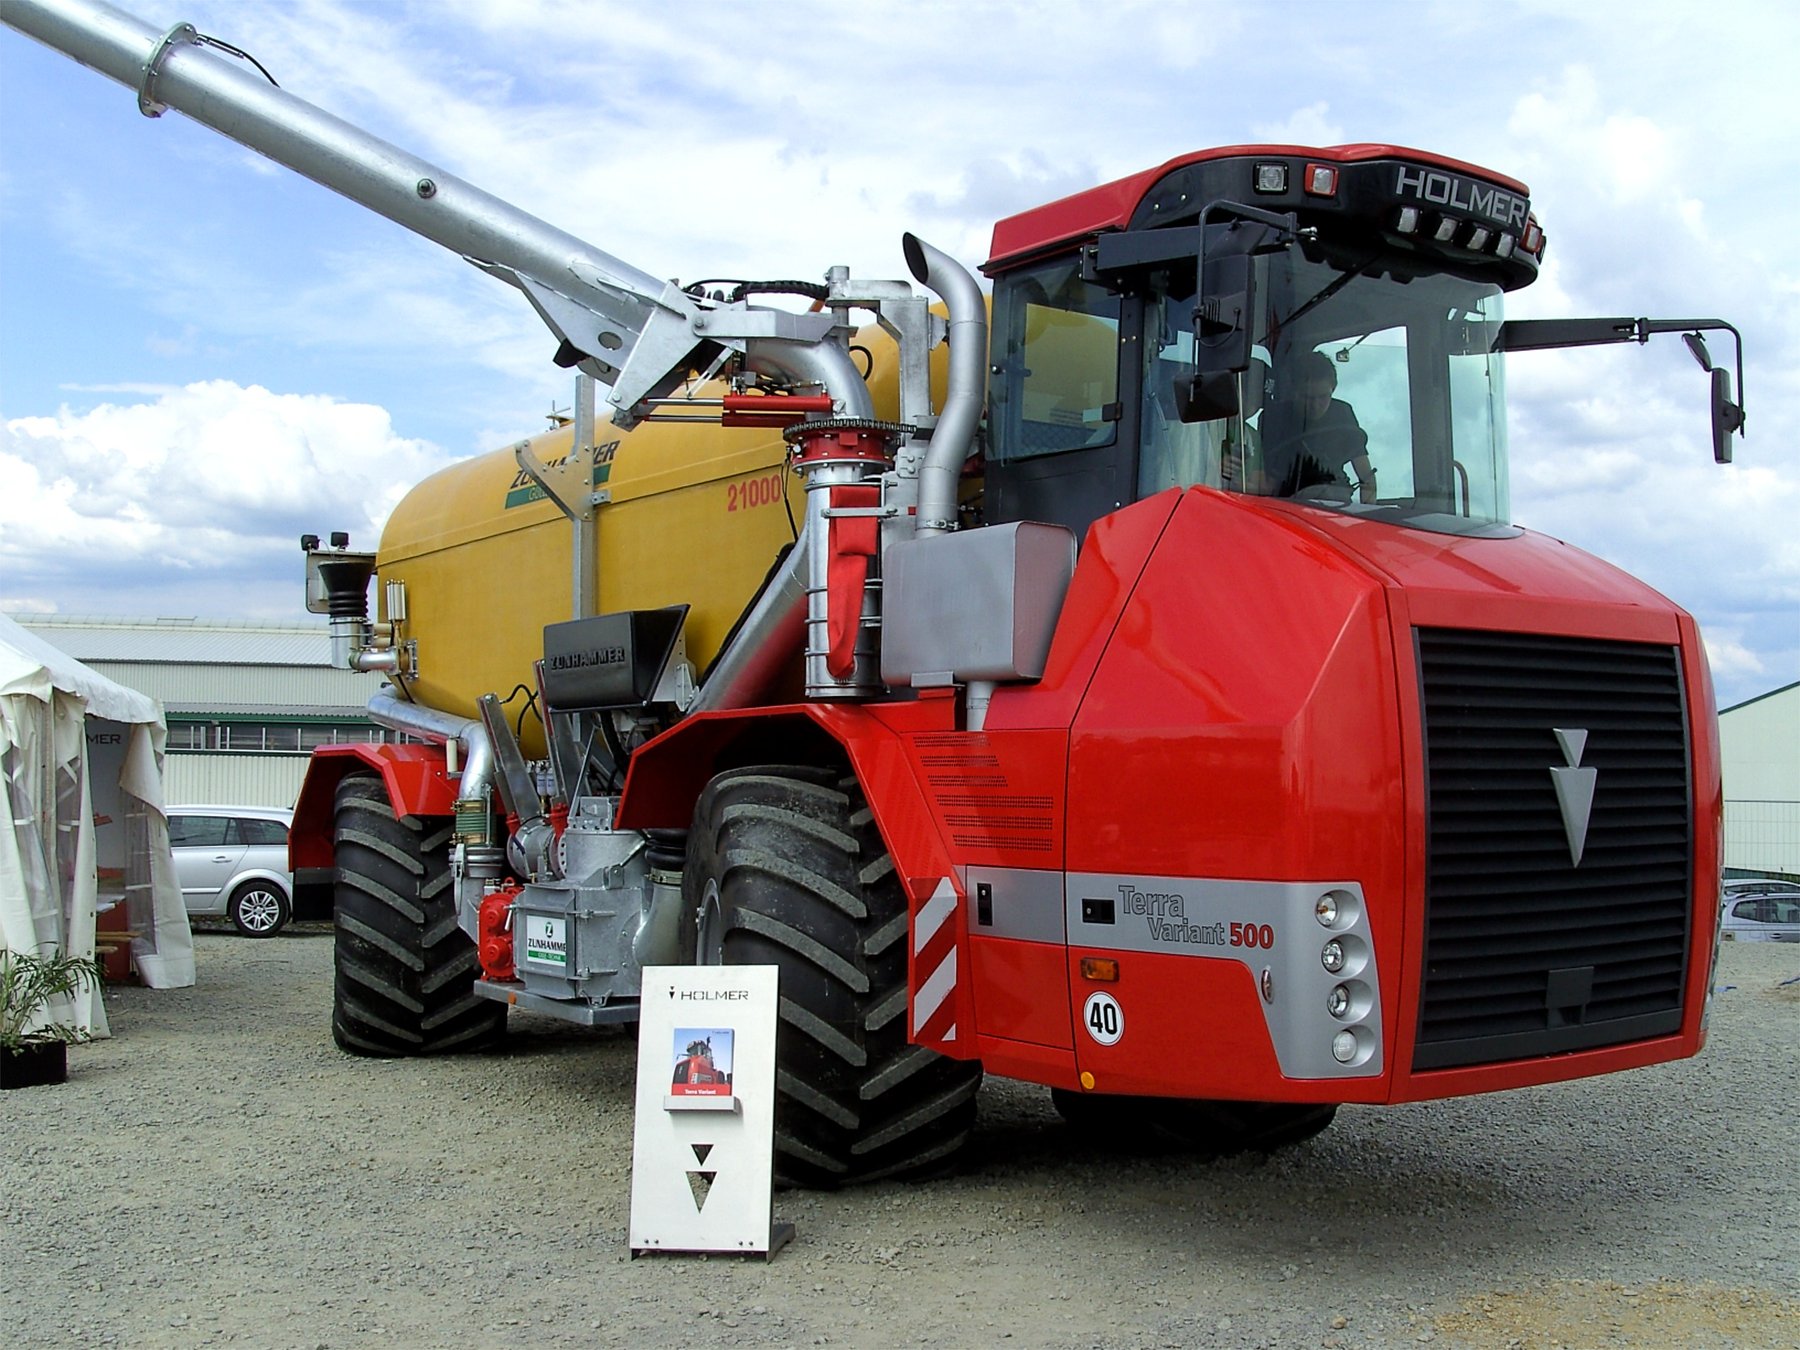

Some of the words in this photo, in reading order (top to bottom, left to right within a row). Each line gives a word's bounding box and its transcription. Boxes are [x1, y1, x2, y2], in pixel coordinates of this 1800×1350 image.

[1396, 166, 1526, 228] HOLMER
[727, 473, 781, 512] 21000
[551, 647, 625, 670] ZUNHAMMER
[1118, 884, 1184, 917] Terra
[1147, 917, 1226, 945] Variant
[1230, 922, 1274, 949] 500
[681, 990, 749, 1000] HOLMER
[1090, 1002, 1117, 1035] 40
